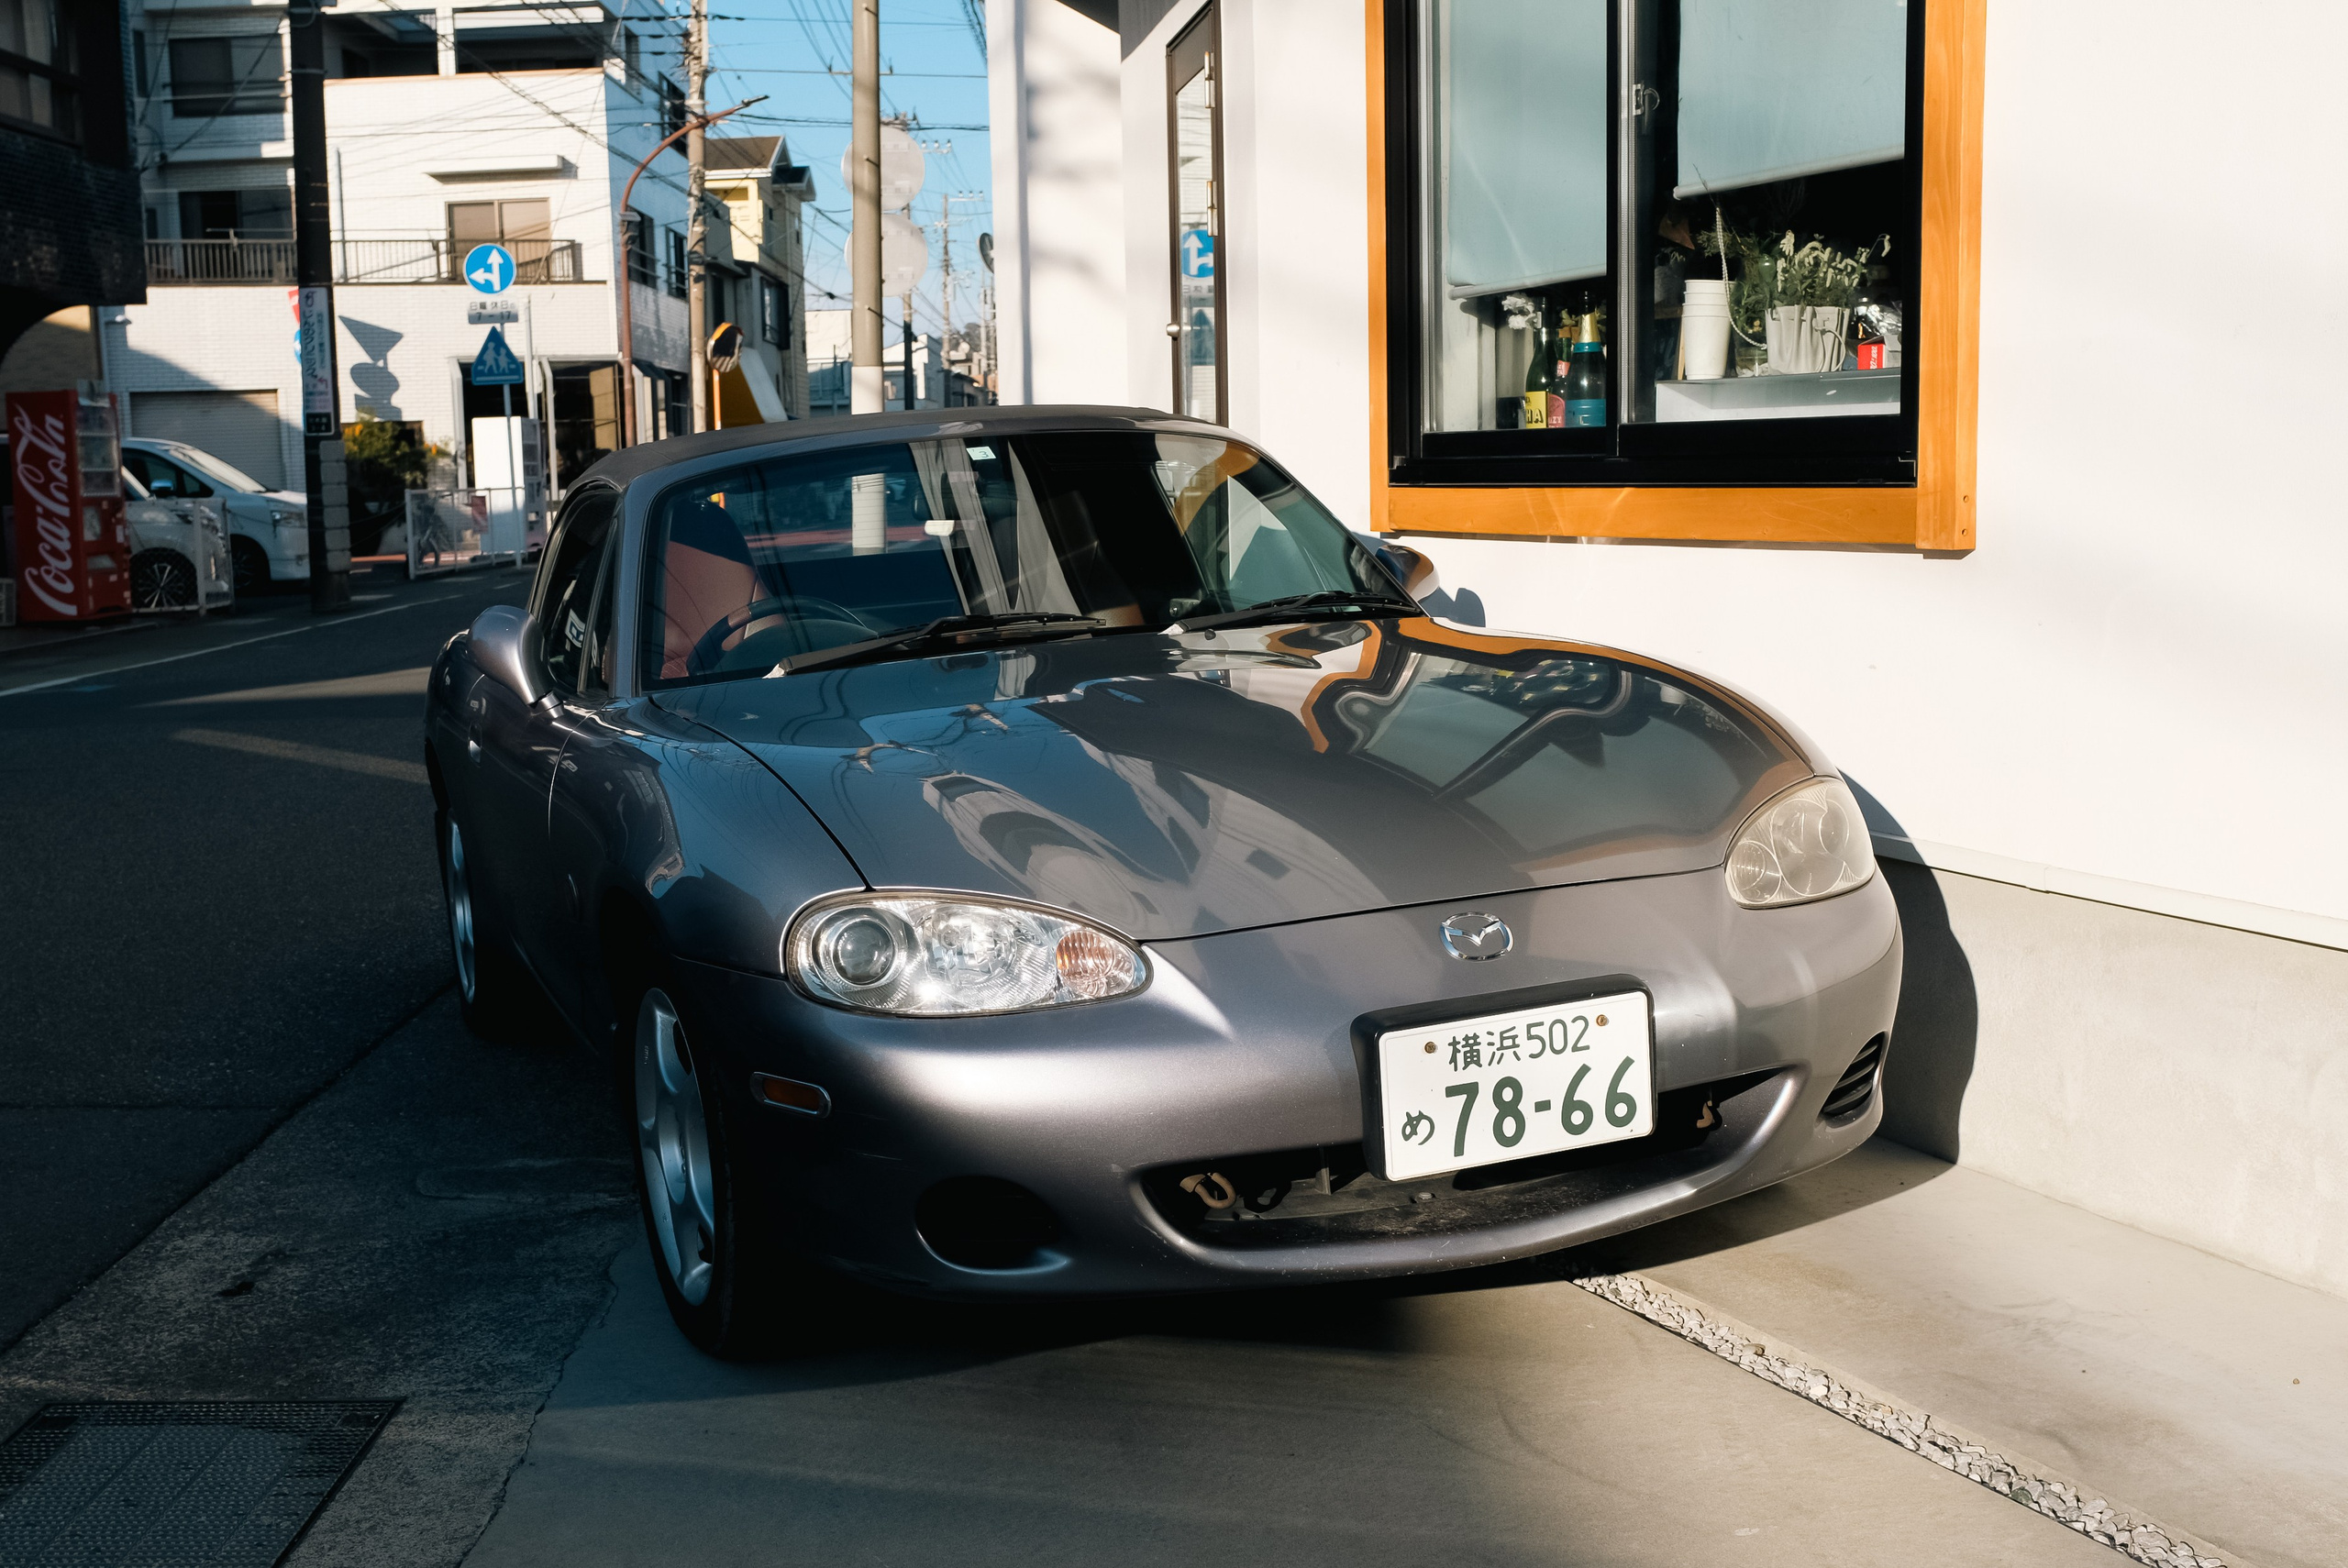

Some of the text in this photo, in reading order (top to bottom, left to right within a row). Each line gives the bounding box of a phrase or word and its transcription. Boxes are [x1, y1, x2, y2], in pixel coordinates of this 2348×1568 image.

[979, 450, 990, 458] 3
[1401, 1055, 1637, 1158] め 78-66
